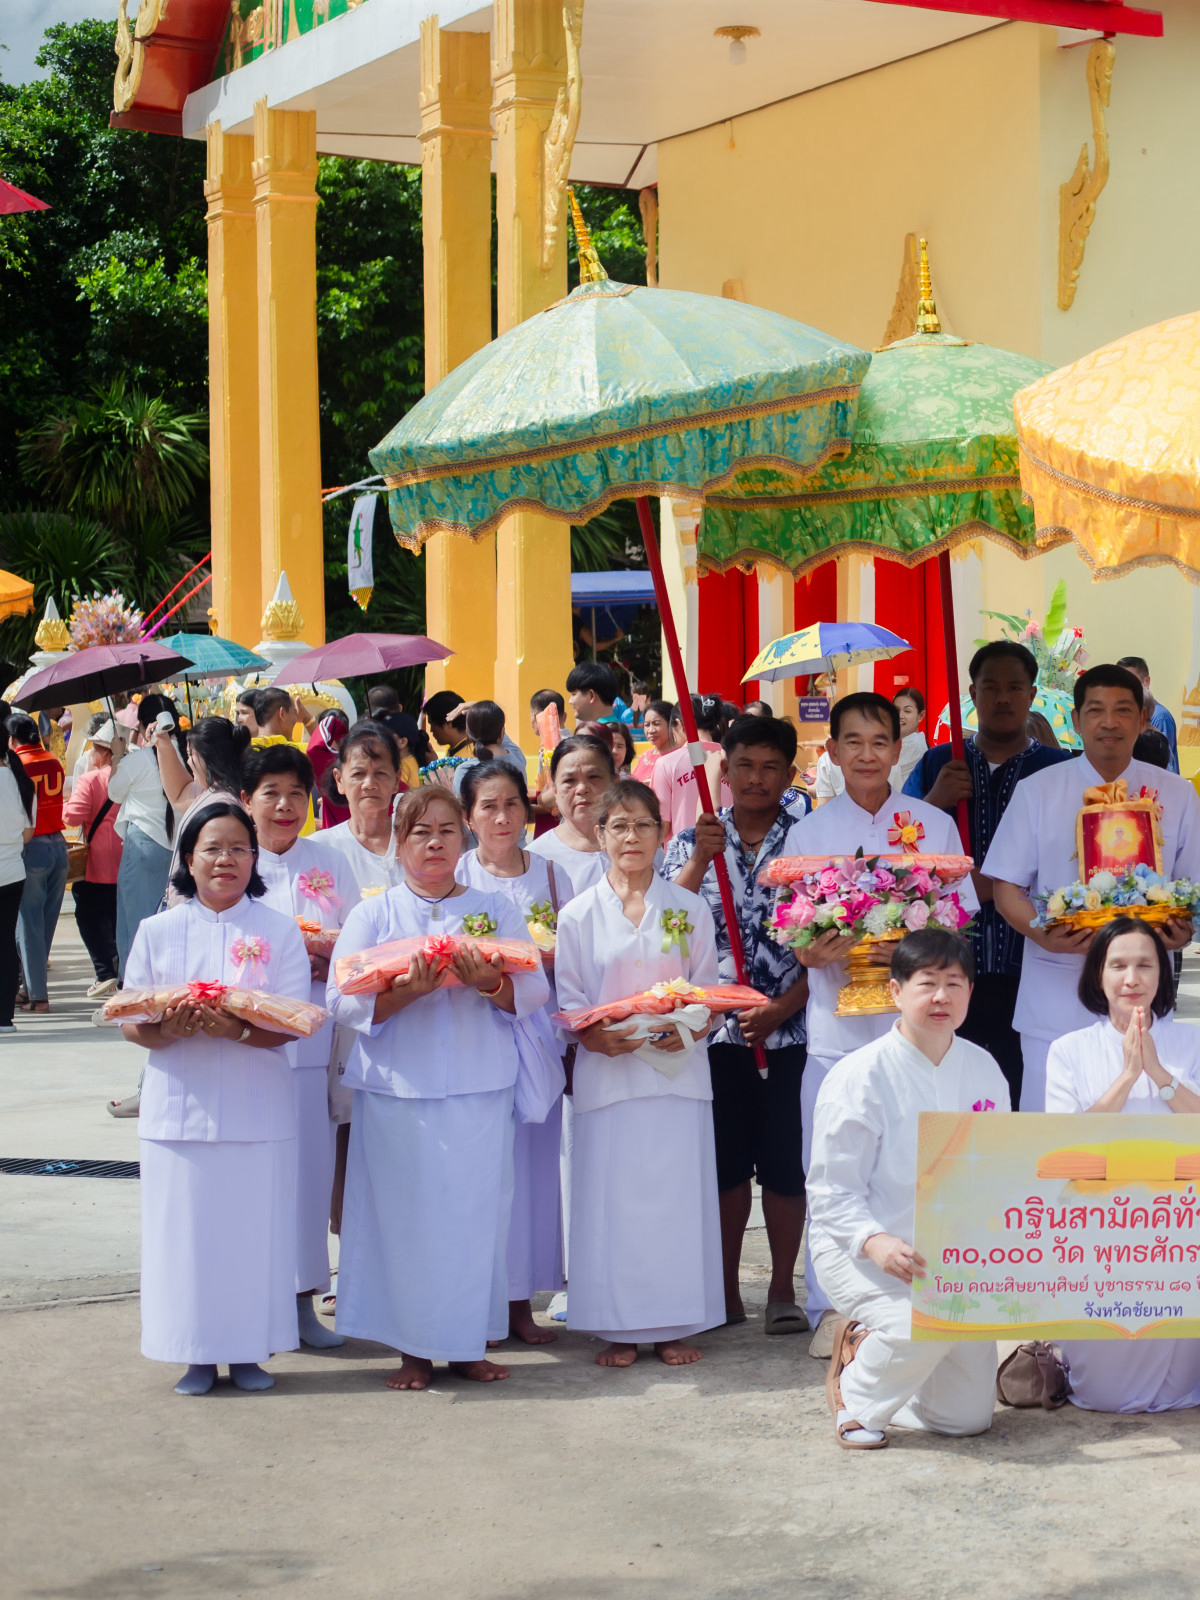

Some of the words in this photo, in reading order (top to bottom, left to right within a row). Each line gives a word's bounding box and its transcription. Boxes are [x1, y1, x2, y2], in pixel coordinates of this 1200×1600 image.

[942, 1247, 1043, 1268] ๓๐,๐๐๐
[1052, 1235, 1084, 1264] วัด
[934, 1275, 963, 1293] โดย
[968, 1273, 1089, 1299] คณะศิษยานุศิษย์
[1094, 1280, 1165, 1298] บูชาธรรม
[1169, 1280, 1191, 1292] ๘๑
[1084, 1300, 1183, 1318] จังหวัดชัยนาท
